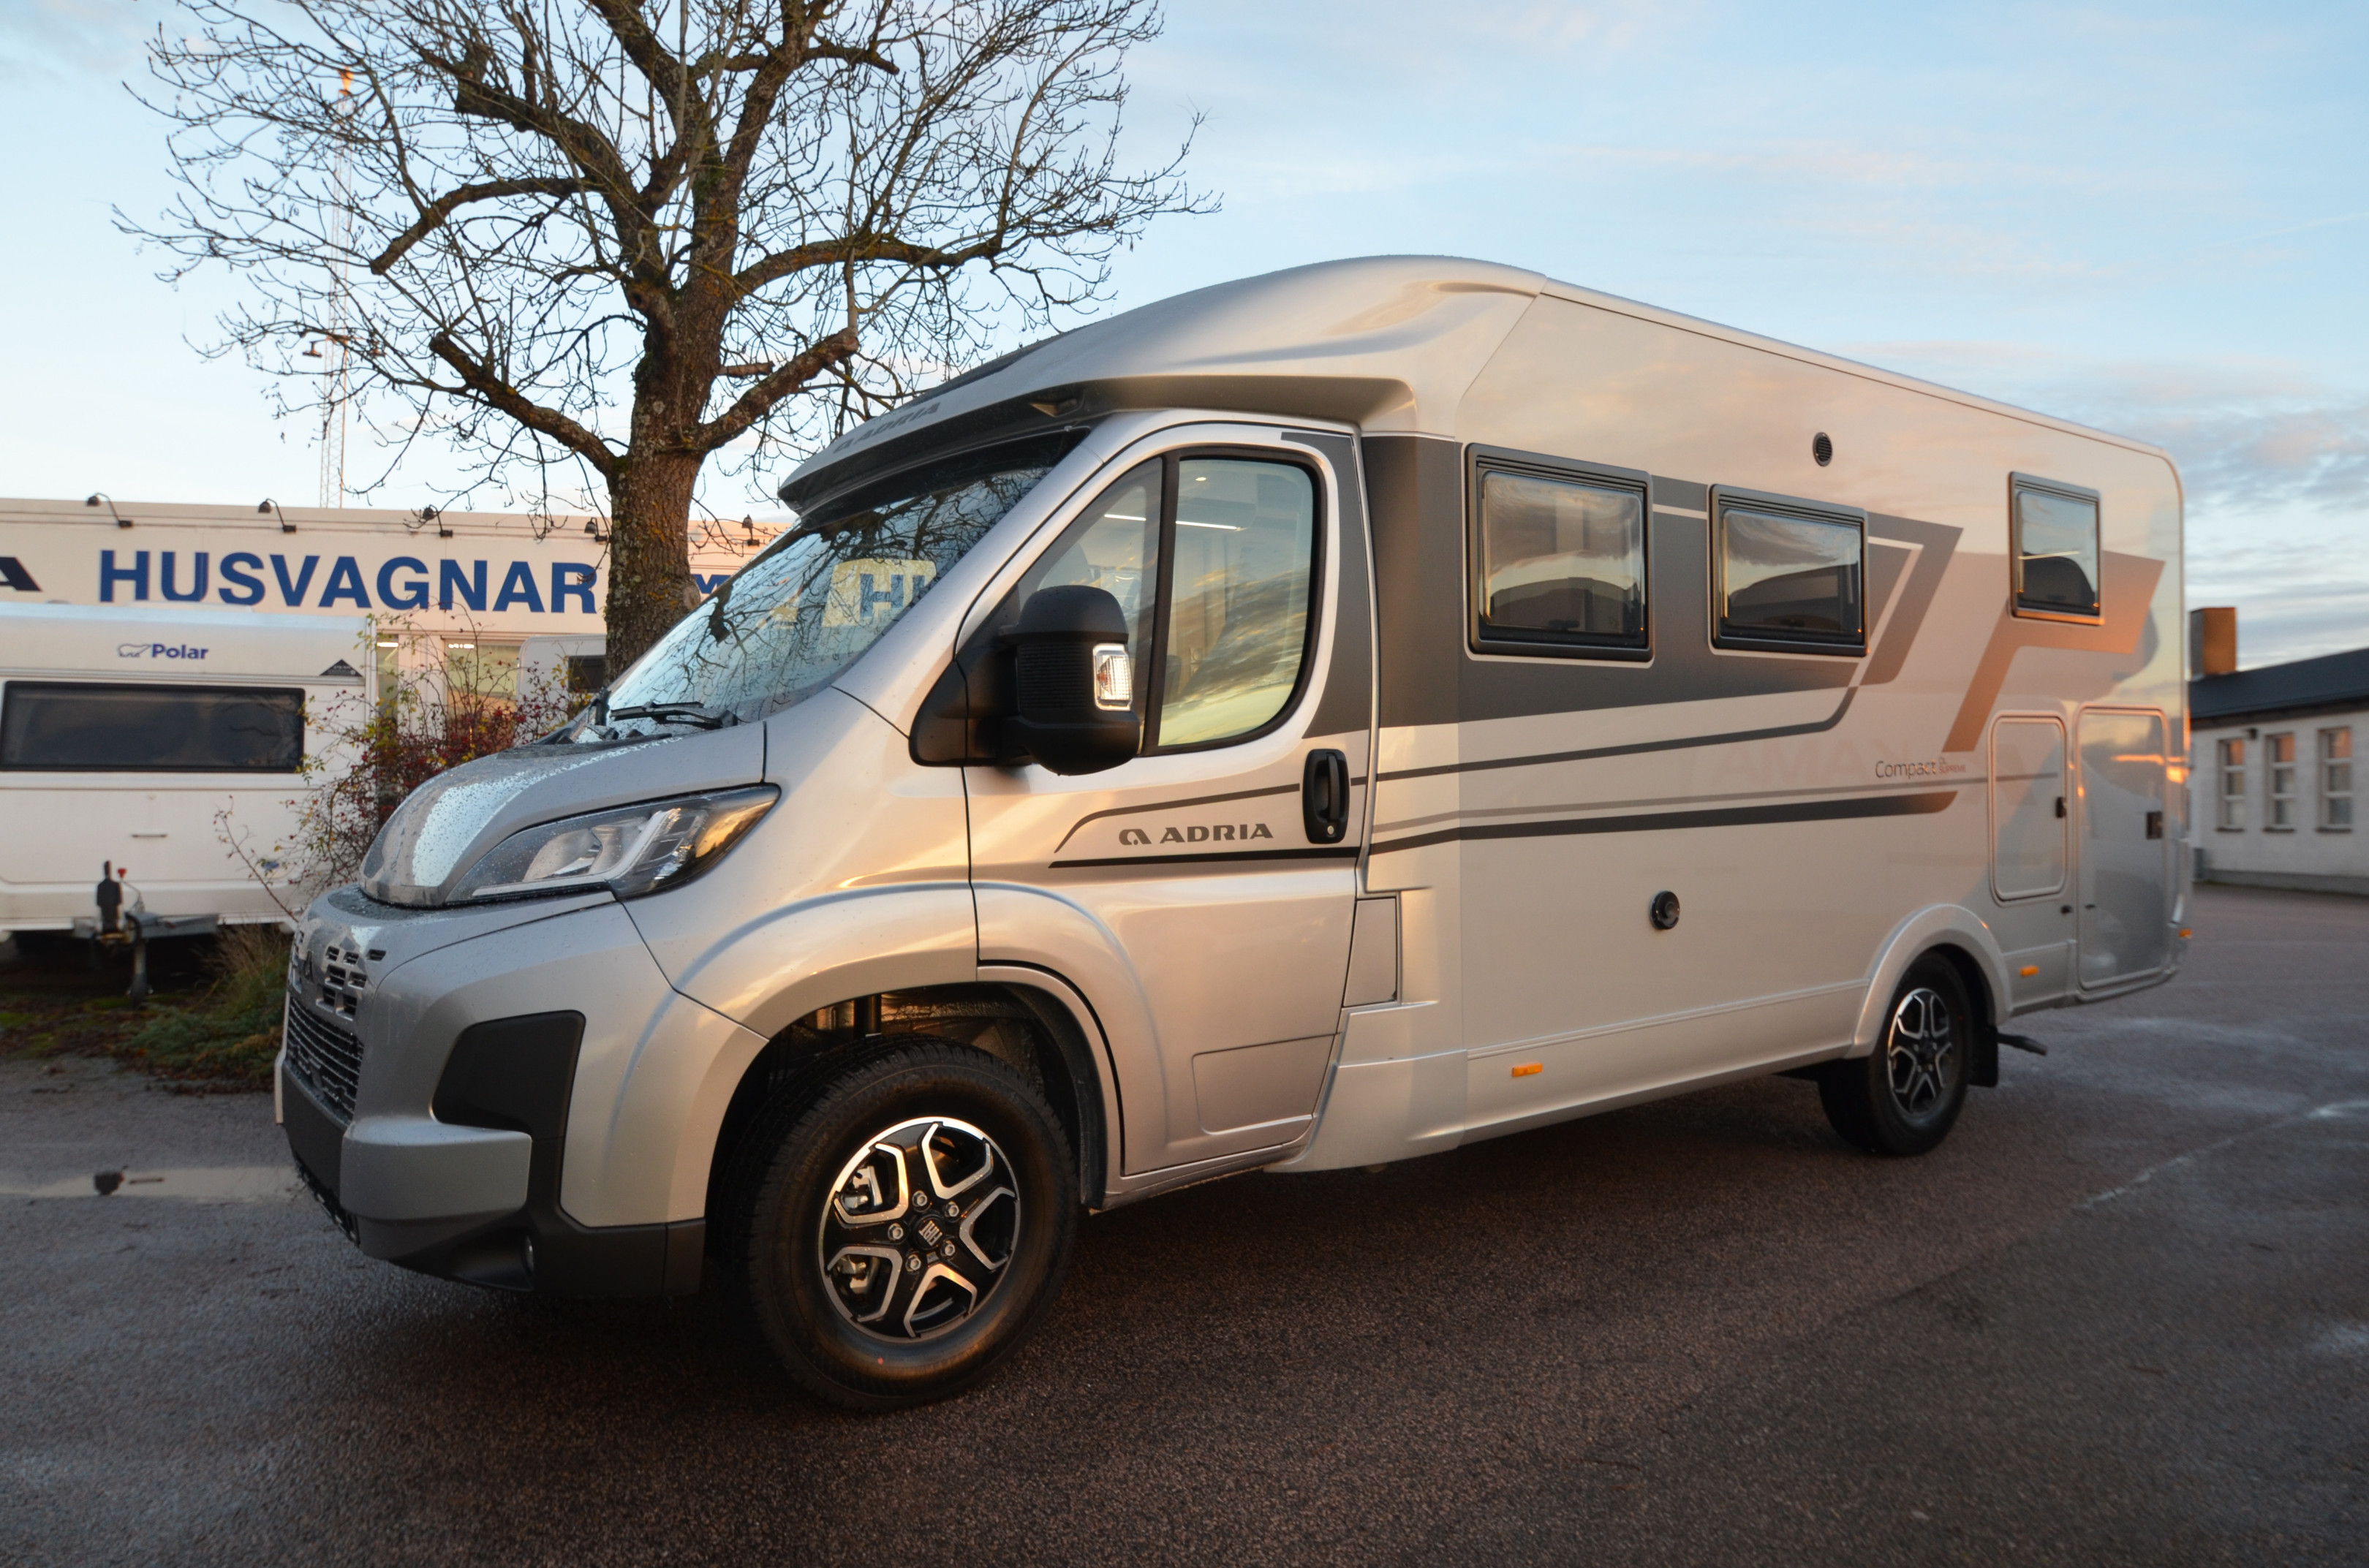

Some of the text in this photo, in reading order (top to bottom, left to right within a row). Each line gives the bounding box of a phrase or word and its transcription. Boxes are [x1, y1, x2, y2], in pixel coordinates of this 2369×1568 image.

[853, 402, 942, 445] ADRIA
[99, 550, 597, 614] HUSVAGNAR
[151, 643, 209, 659] Polar
[1875, 759, 1937, 779] Compact
[1160, 823, 1274, 844] ADRIA
[918, 1220, 943, 1246] FIAT
